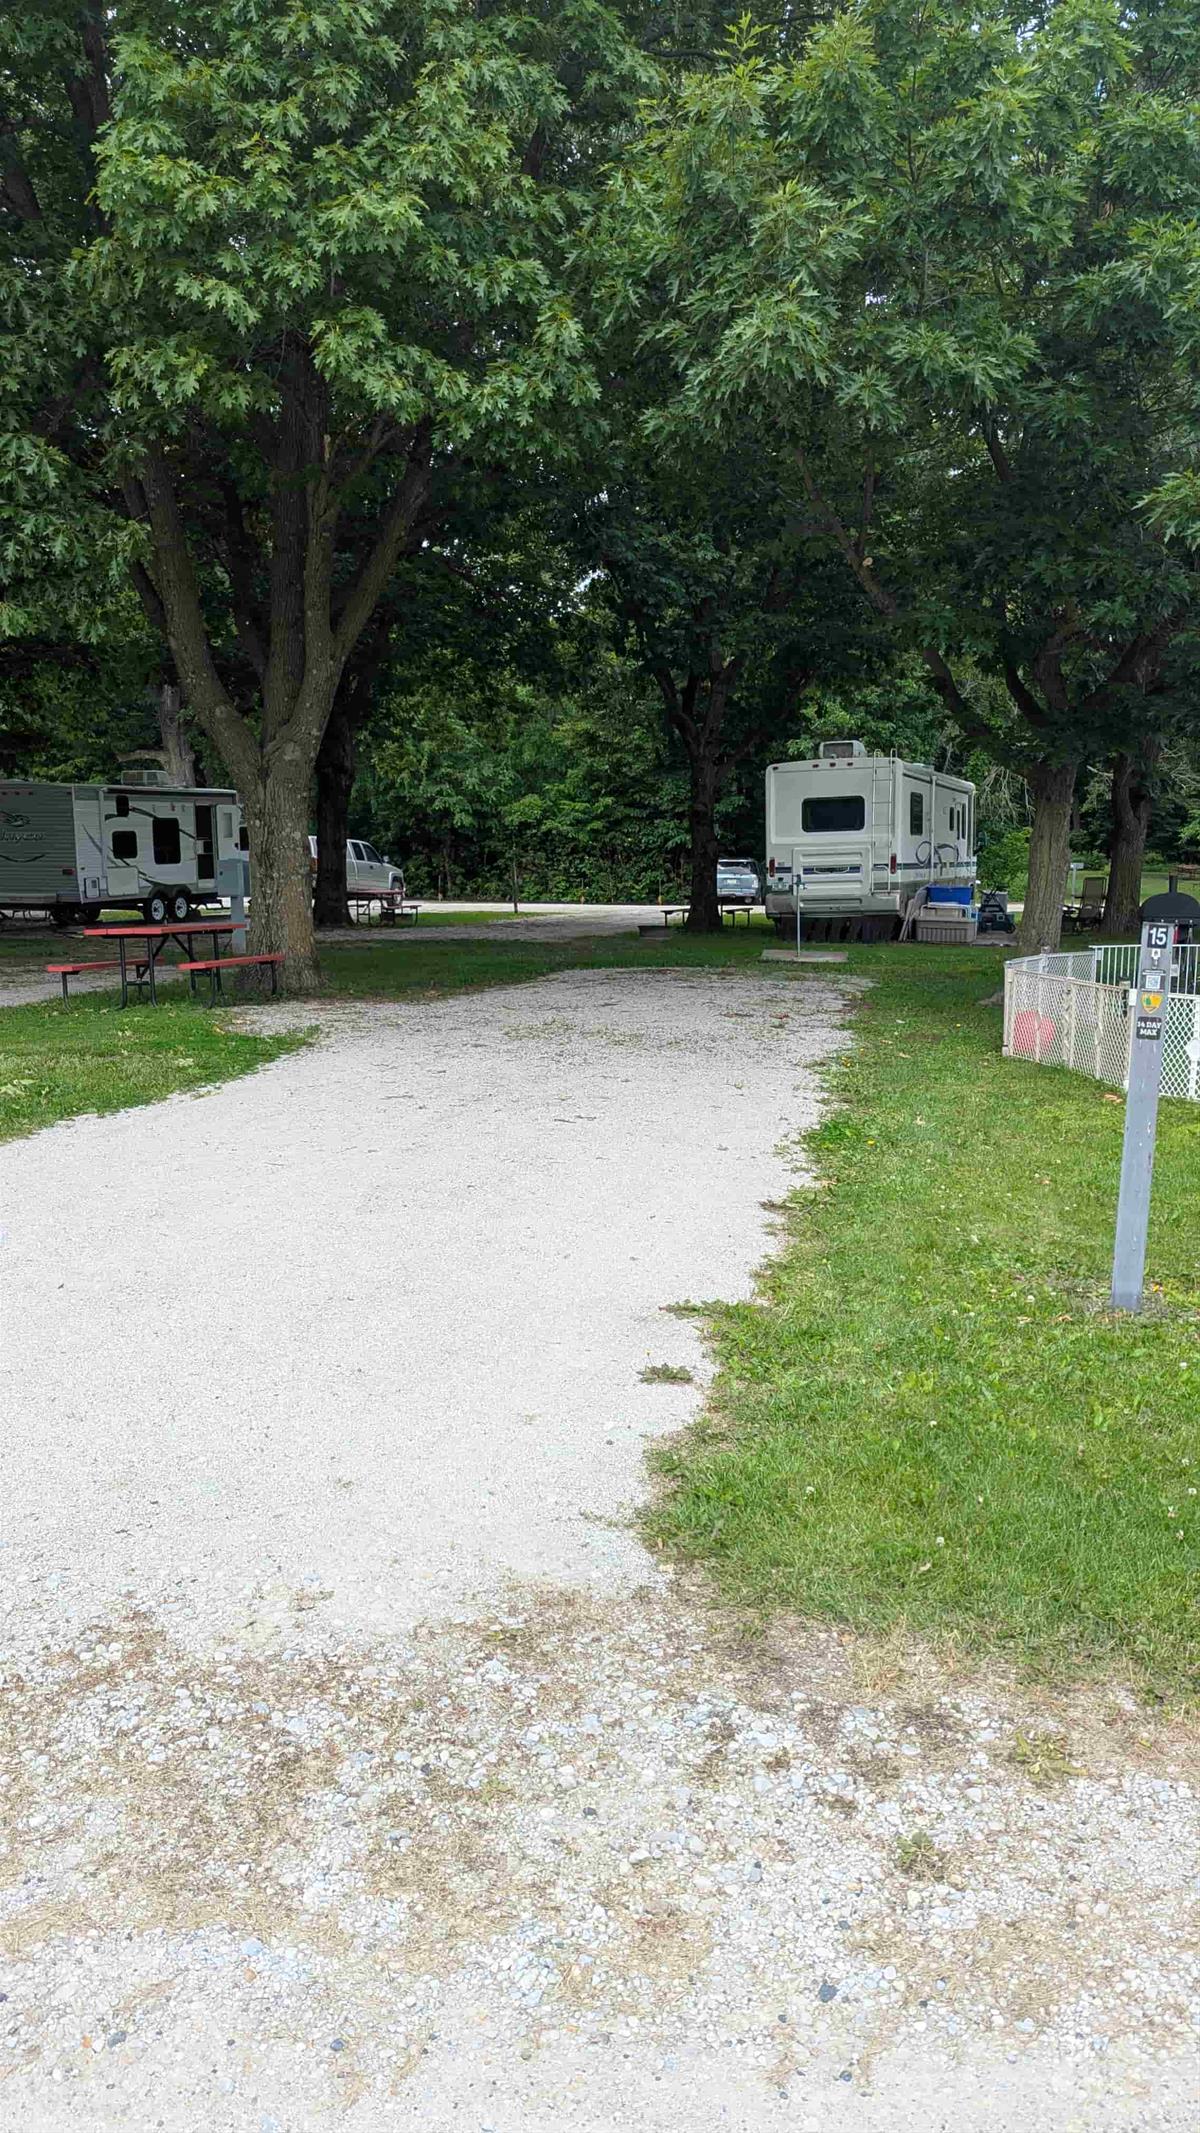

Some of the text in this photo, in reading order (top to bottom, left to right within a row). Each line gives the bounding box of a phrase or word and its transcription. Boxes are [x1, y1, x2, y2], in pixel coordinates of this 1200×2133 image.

[1149, 927, 1167, 945] 15
[1146, 1021, 1162, 1029] DAY
[1139, 1028, 1158, 1036] MAX
